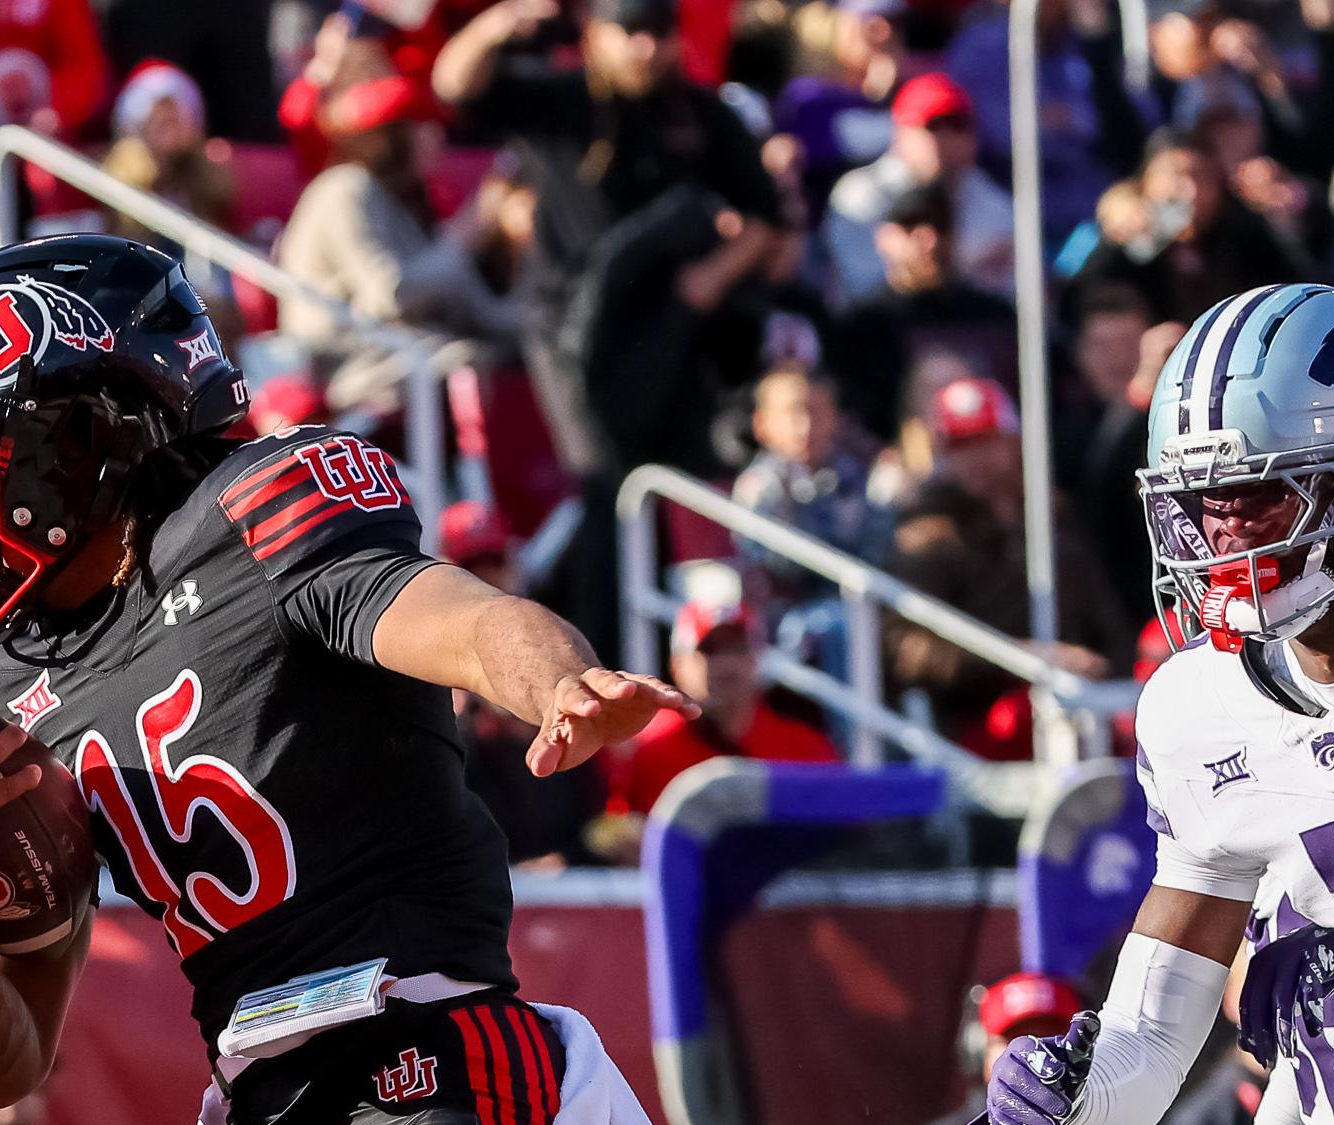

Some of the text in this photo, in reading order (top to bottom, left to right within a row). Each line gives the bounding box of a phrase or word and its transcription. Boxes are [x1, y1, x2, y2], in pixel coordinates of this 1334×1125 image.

[178, 329, 218, 370] XII
[8, 670, 63, 731] XII
[1203, 747, 1255, 796] XII
[75, 668, 297, 960] 15
[14, 829, 43, 872] ISSUE
[38, 874, 57, 910] TEAM
